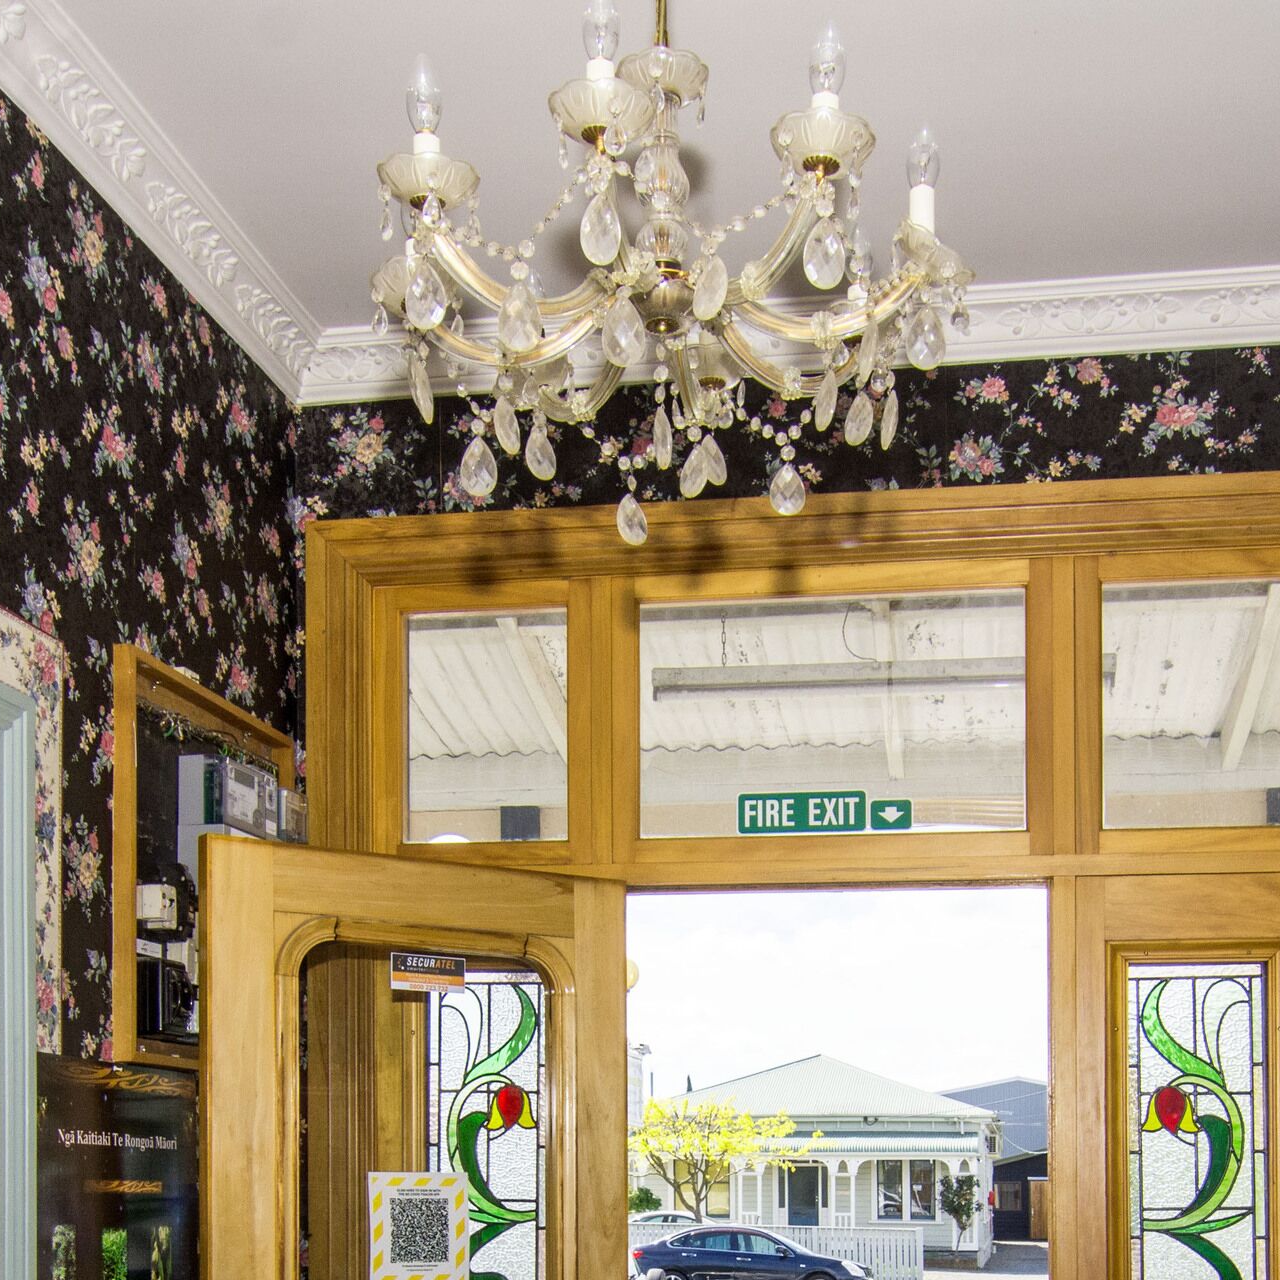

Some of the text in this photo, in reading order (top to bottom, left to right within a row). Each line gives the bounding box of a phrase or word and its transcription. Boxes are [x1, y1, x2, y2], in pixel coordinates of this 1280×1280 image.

[744, 797, 860, 828] FIRE EXIT
[406, 956, 456, 969] SECURATEL
[58, 1128, 177, 1151] Ngā Kaitiaki Te Rongoā Māori
